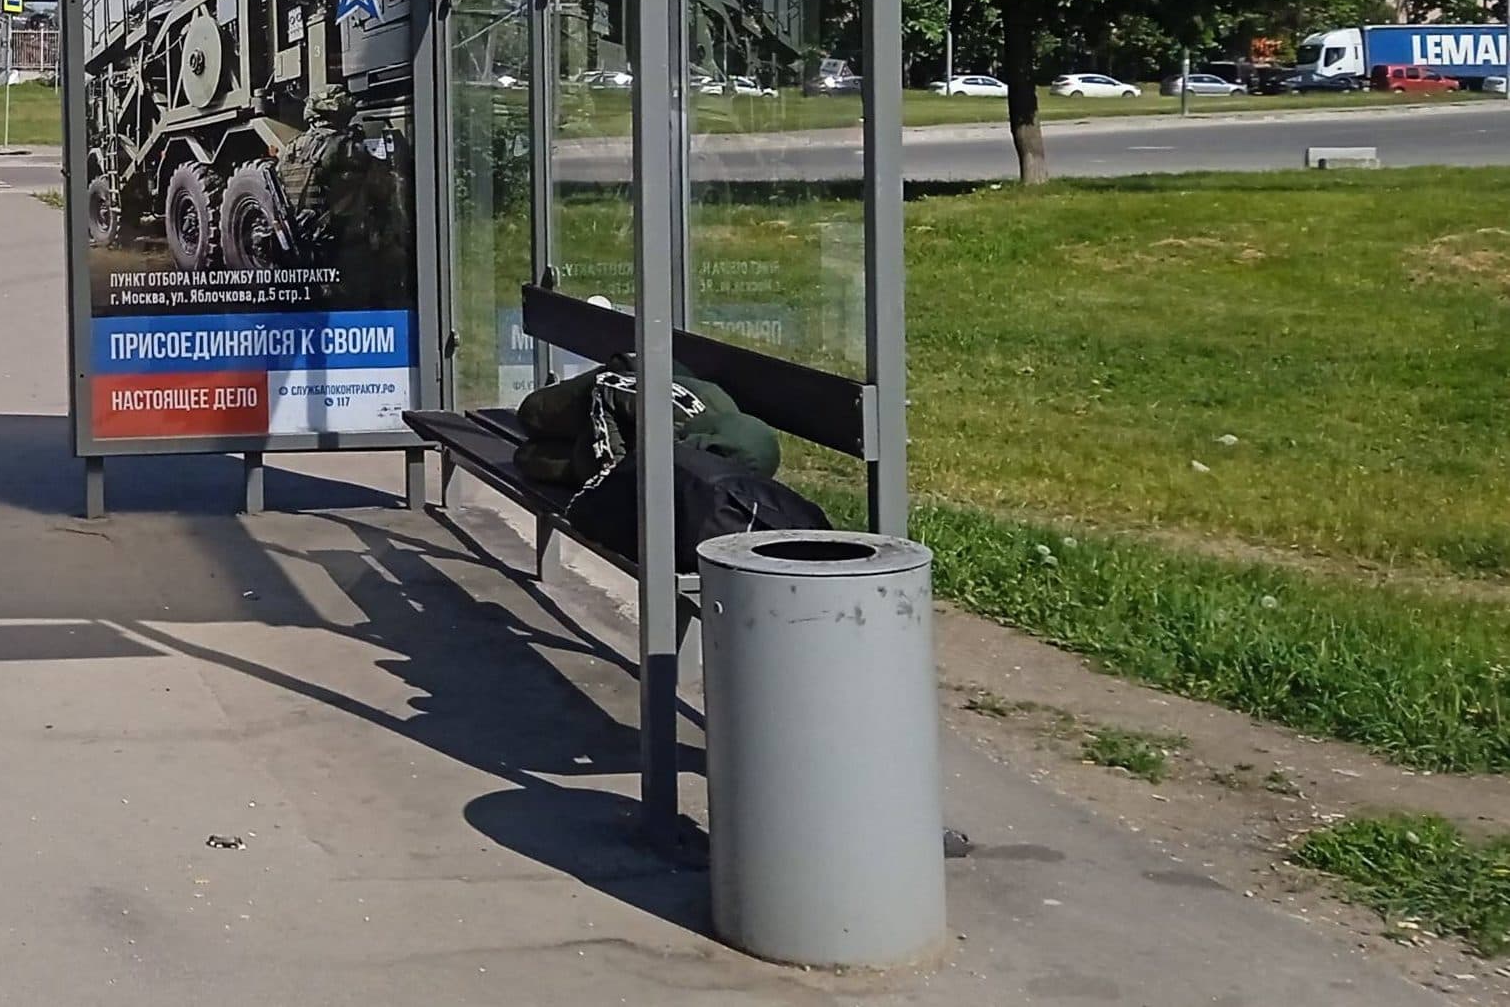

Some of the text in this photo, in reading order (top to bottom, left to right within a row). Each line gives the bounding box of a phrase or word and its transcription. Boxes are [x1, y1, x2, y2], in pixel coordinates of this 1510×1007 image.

[110, 268, 340, 287] ПУНКТ ОТБОРА НА СЛУЖБУ ПО КОНТРАКТУ:
[110, 294, 119, 305] г.
[278, 289, 302, 304] стр.
[304, 286, 311, 300] 1
[110, 324, 395, 360] ПРИСОЕДИНЯЙСЯ К СВОИМ
[112, 387, 258, 411] НАСТОЯЩЕЕ ДЕЛО
[291, 383, 395, 396] СЛУЖБАПОКОНТРАКТУ.РФ
[336, 397, 350, 406] 117
